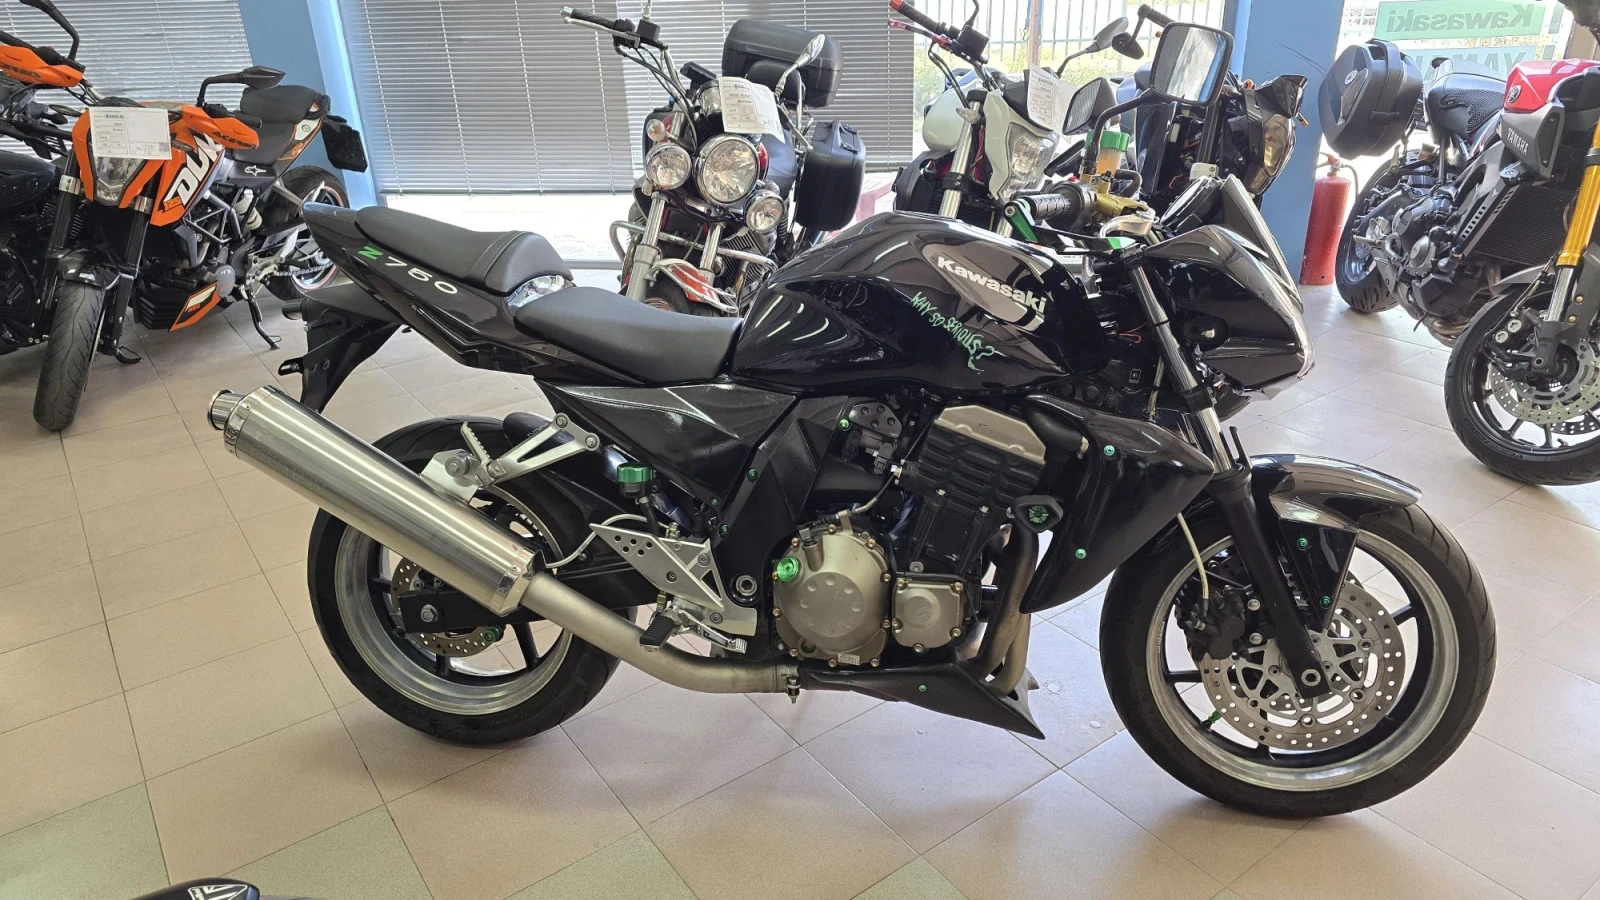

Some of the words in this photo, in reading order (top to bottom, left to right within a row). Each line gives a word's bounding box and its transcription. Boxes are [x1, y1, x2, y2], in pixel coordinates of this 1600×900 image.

[1507, 128, 1529, 156] YAMAHA
[163, 132, 225, 206] DUK
[937, 256, 1047, 314] Kawasaki
[910, 291, 938, 316] WHY
[928, 312, 946, 327] SO
